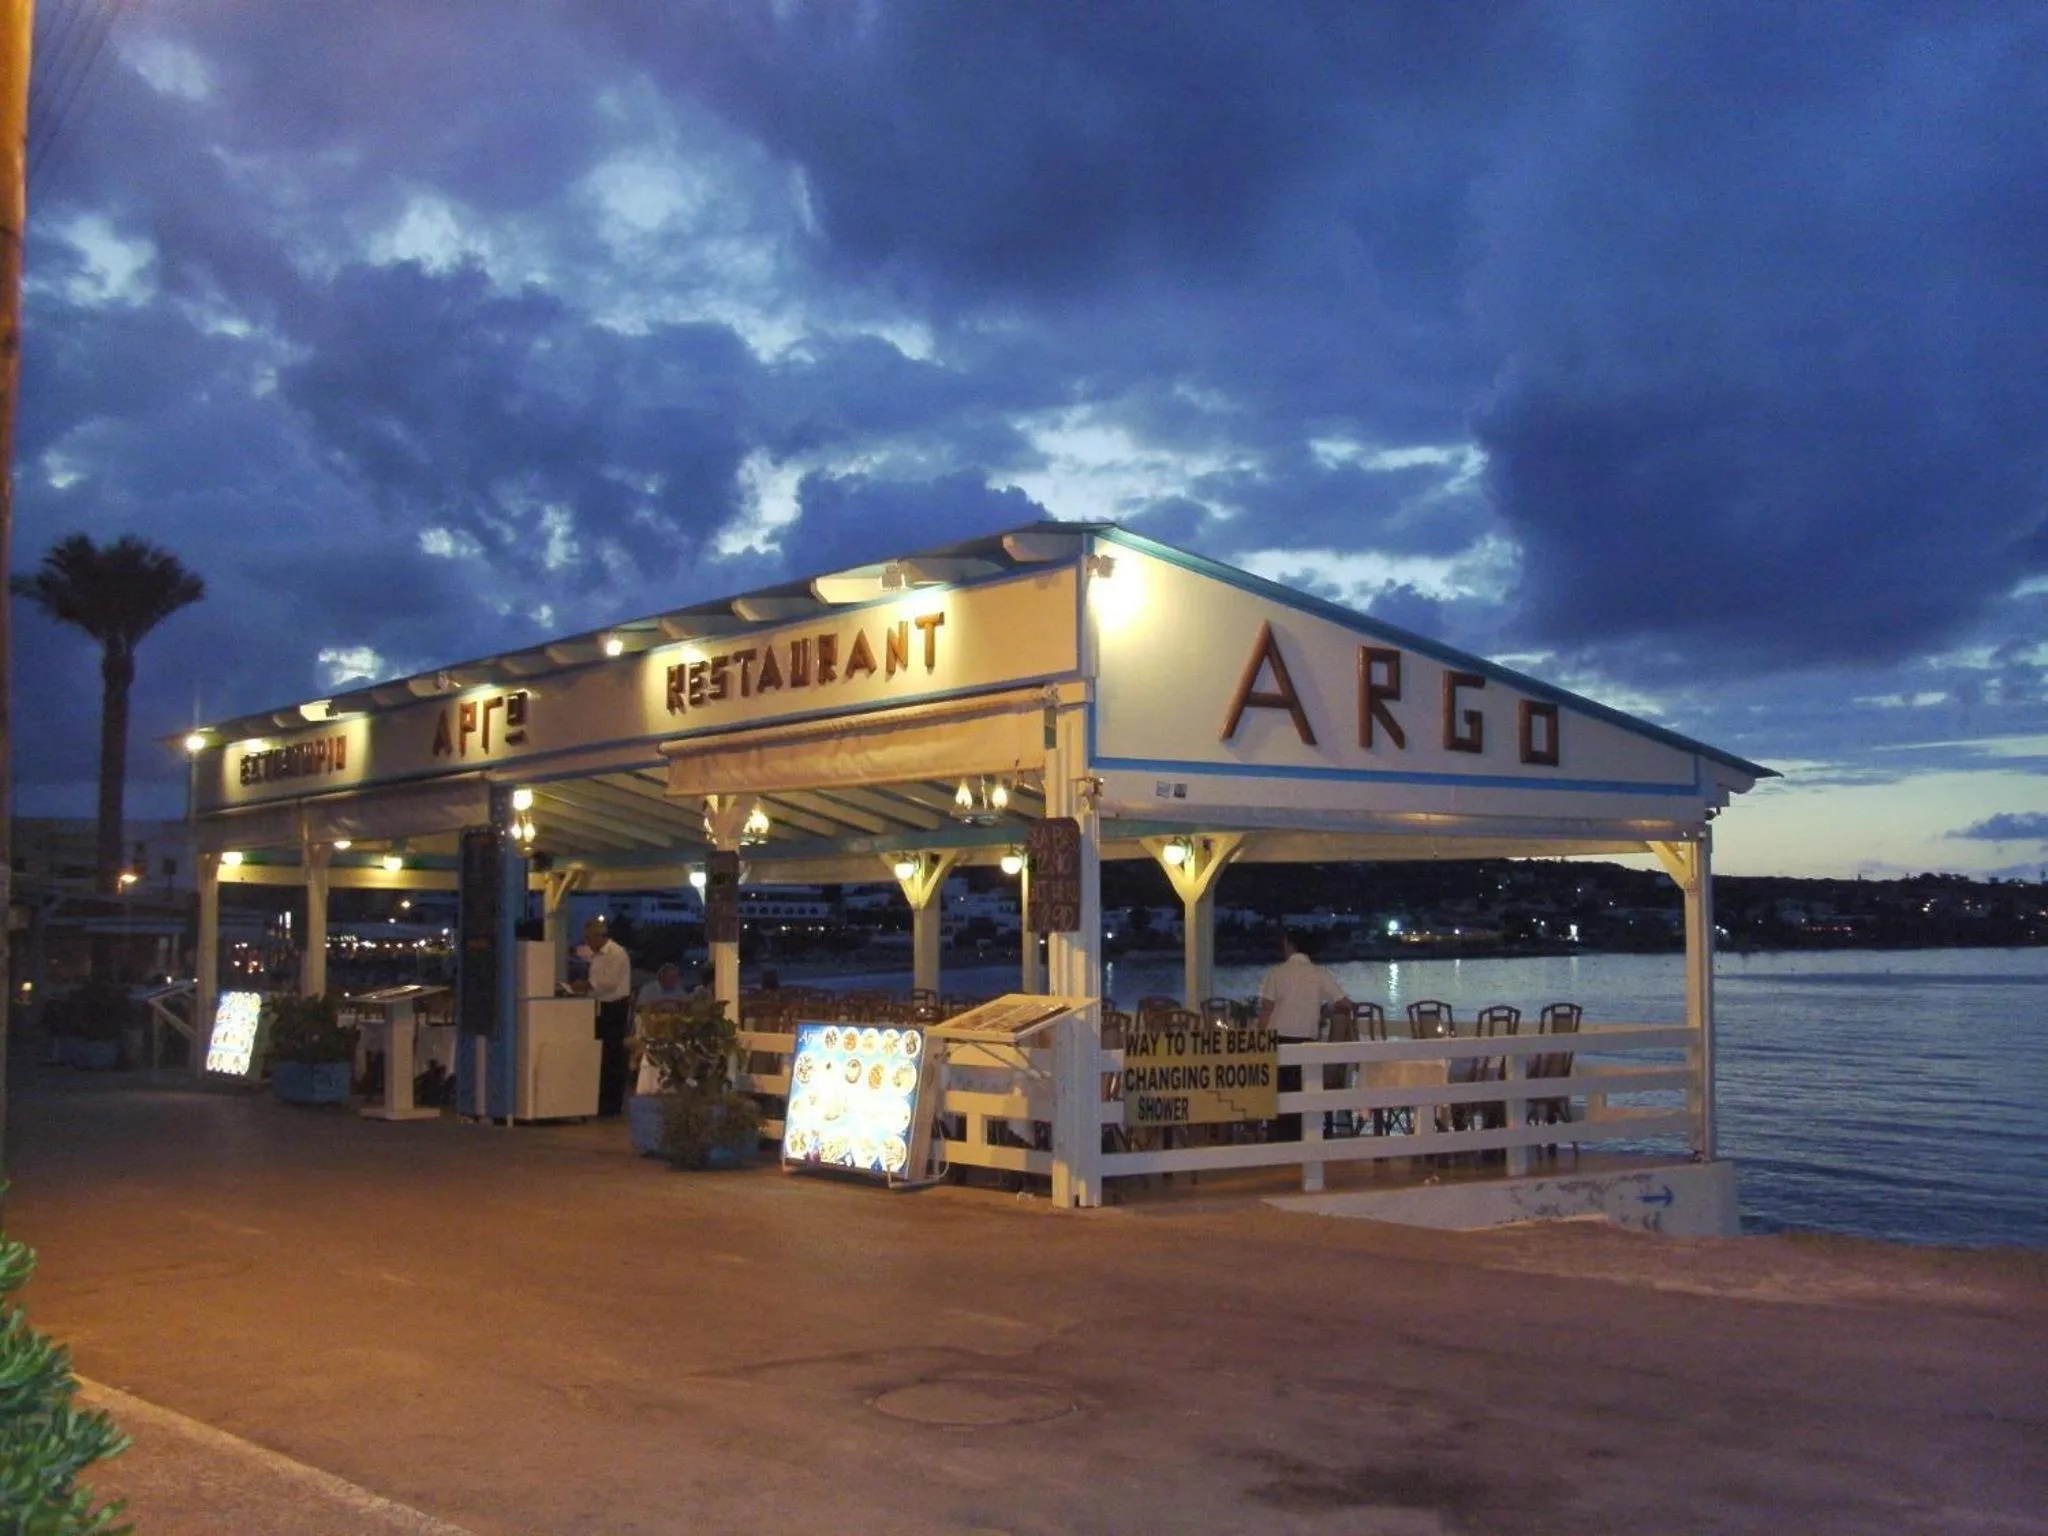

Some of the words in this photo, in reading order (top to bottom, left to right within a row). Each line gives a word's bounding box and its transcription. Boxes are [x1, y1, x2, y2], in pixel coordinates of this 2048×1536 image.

[667, 612, 945, 714] RESTAURANT
[1219, 620, 1560, 766] ARGO
[1125, 1033, 1160, 1056] WAY
[1165, 1032, 1185, 1055] TO
[1191, 1031, 1222, 1054] THE
[1228, 1029, 1278, 1054] BEACH
[1125, 1065, 1209, 1092] CHANGING
[1215, 1064, 1270, 1088] ROOMS
[1138, 1096, 1189, 1121] SHOWER
